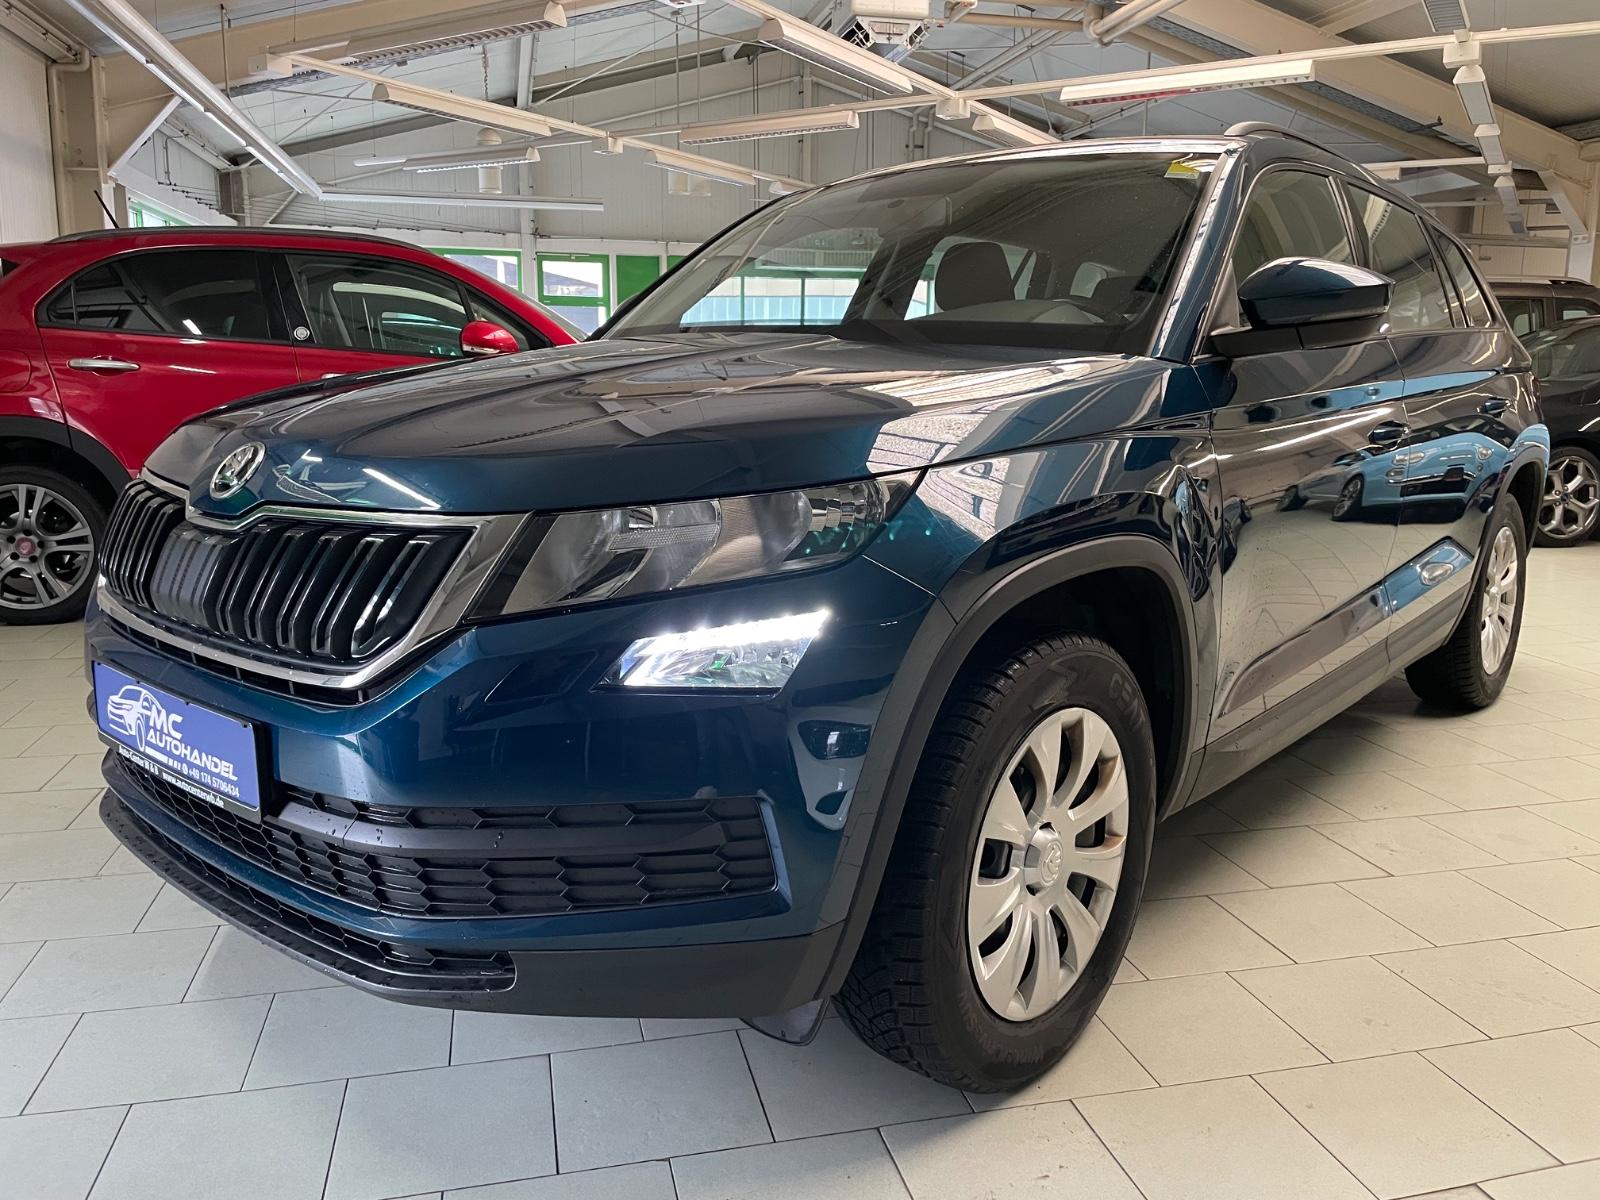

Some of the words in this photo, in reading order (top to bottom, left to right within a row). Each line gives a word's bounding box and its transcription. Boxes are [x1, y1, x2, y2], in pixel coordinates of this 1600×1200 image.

[149, 704, 183, 740] MC
[146, 729, 239, 781] AUTOHANDEL
[188, 767, 200, 780] +49
[200, 771, 212, 785] 174
